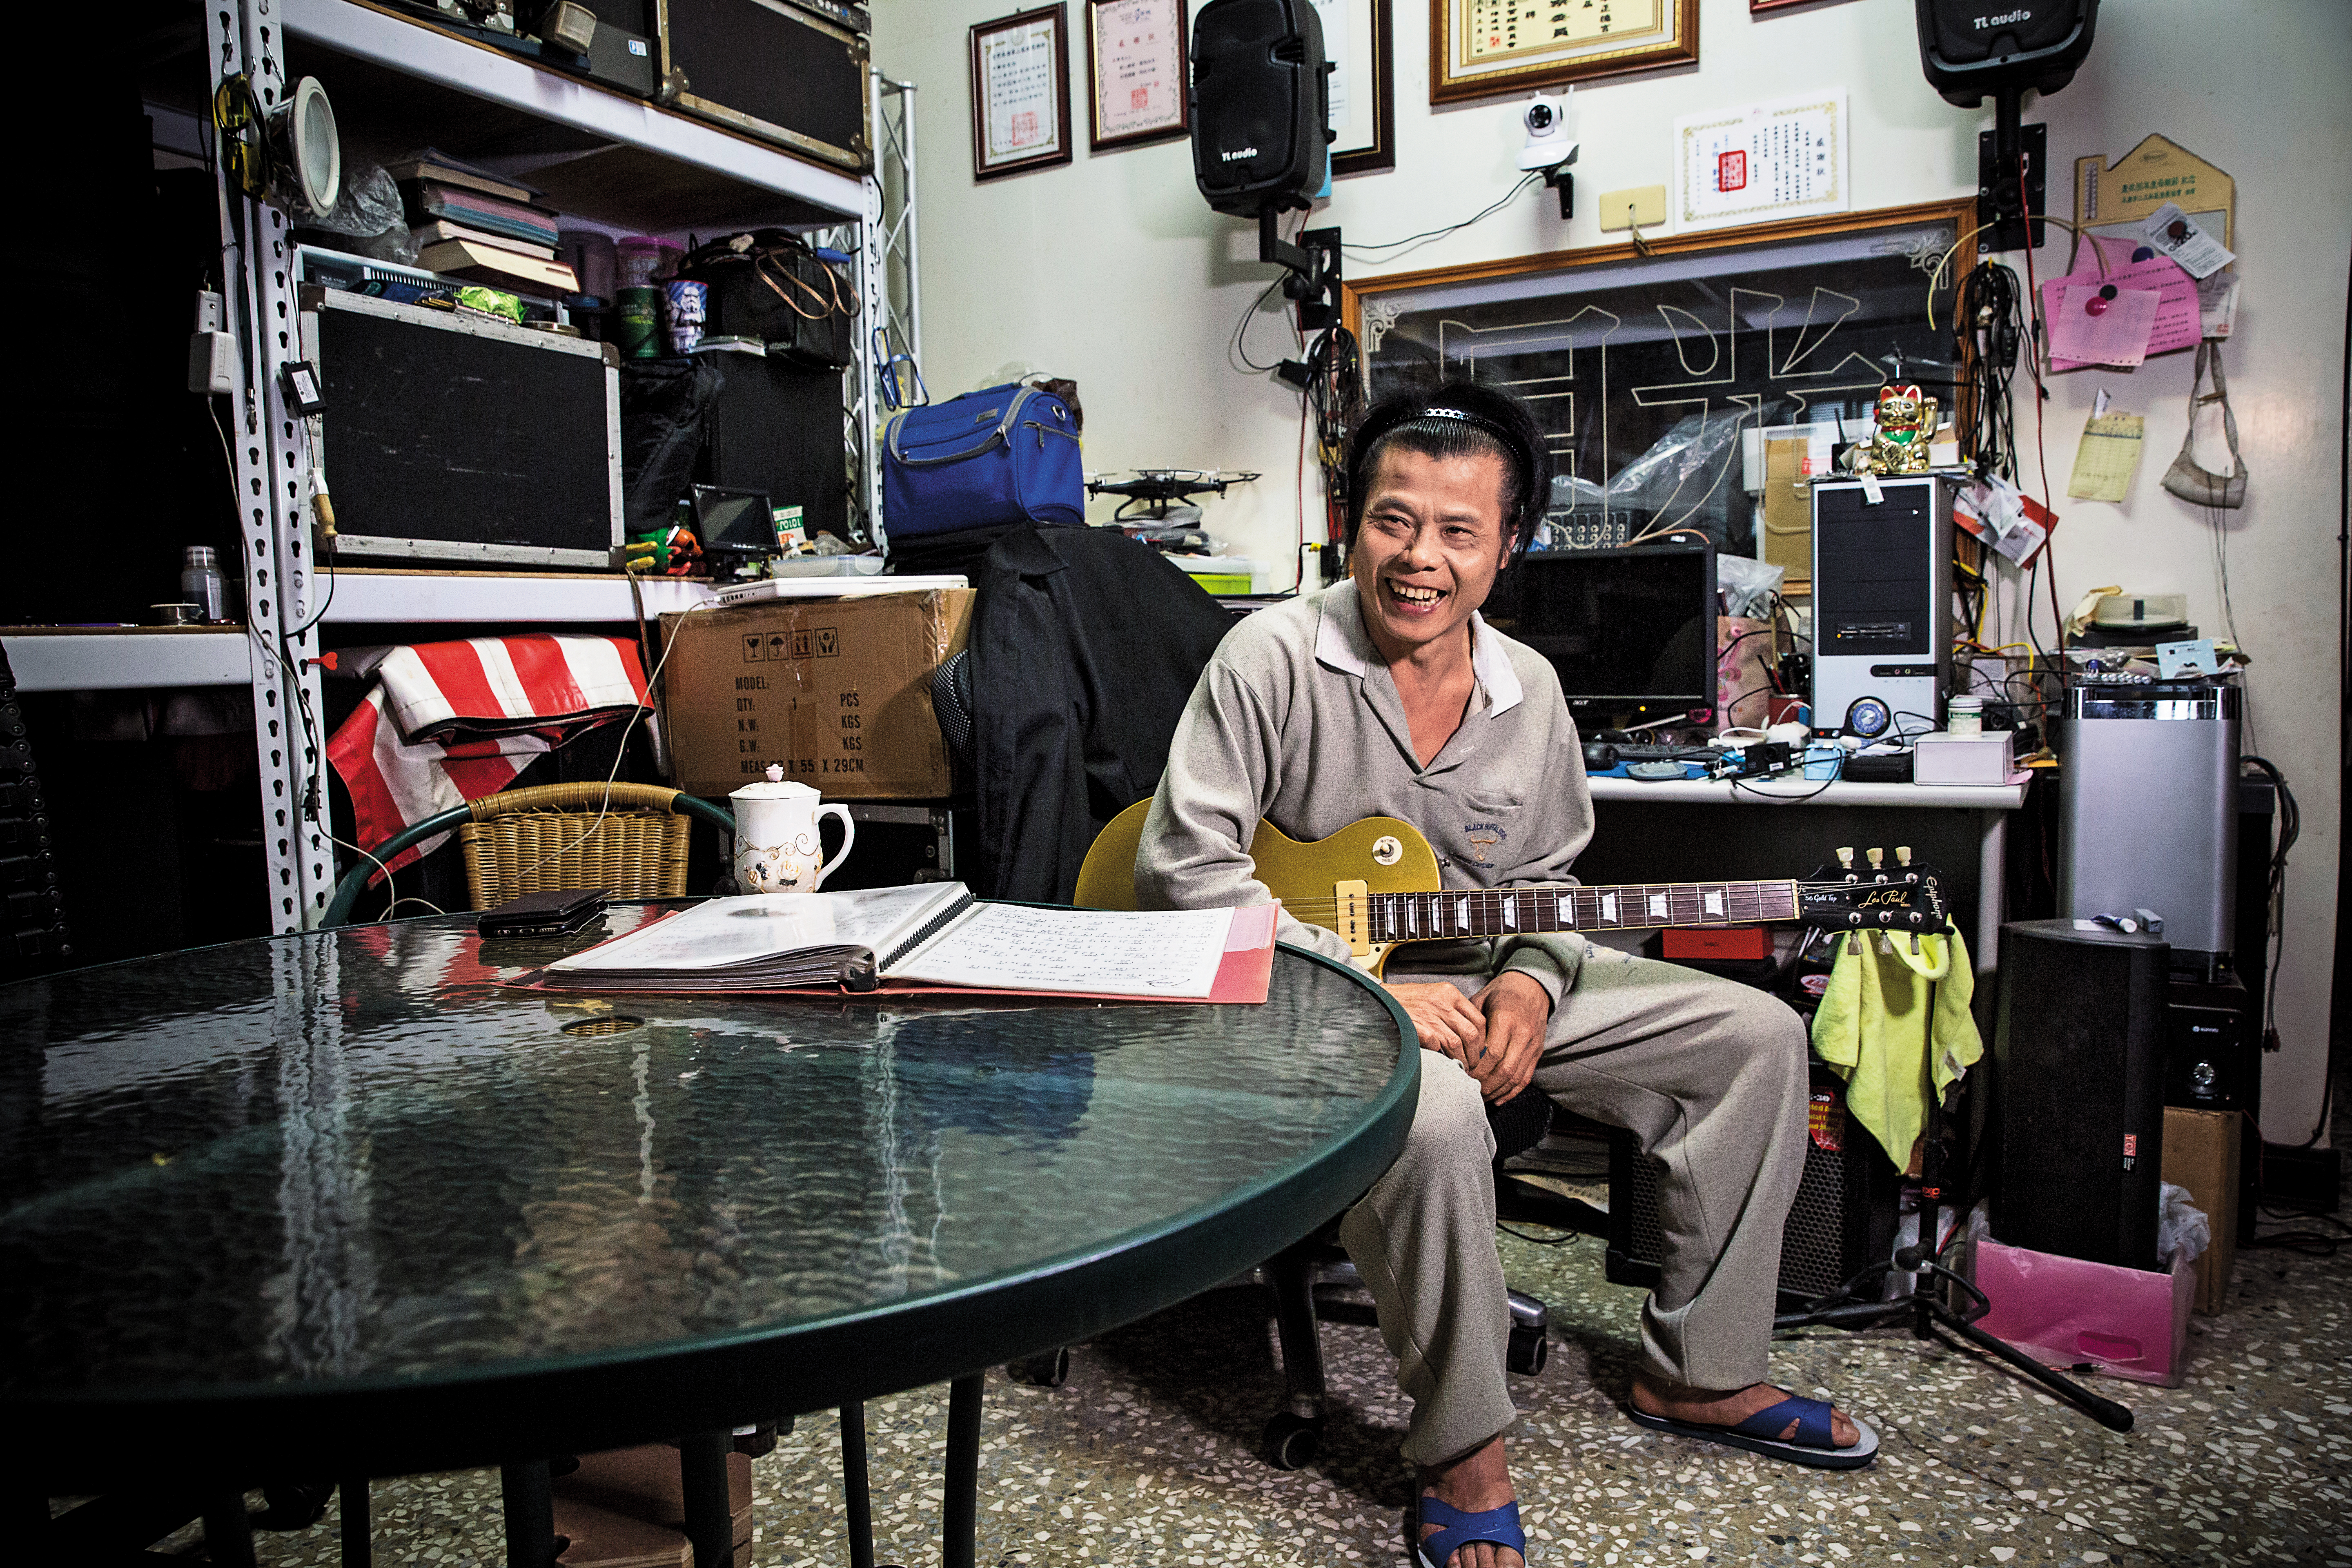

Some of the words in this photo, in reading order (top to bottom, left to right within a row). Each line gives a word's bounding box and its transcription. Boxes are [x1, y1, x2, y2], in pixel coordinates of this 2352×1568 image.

[1990, 9, 2031, 26] audio
[1232, 147, 1258, 160] audio
[735, 676, 770, 690] MODEL:
[737, 697, 755, 712] QTY:
[792, 697, 797, 710] 1
[840, 693, 859, 707] PCS
[842, 715, 860, 729] KGS
[843, 737, 862, 750] KGS
[789, 760, 794, 773] X
[800, 760, 815, 773] 55
[822, 759, 829, 772] X
[834, 758, 864, 772] 29CM
[1465, 823, 1484, 833] BLACK
[1814, 893, 1827, 903] Gold
[1828, 894, 1837, 903] Top
[1858, 891, 1880, 909] Les
[1881, 889, 1908, 905] Paul
[1923, 875, 1942, 919] Epiphone
